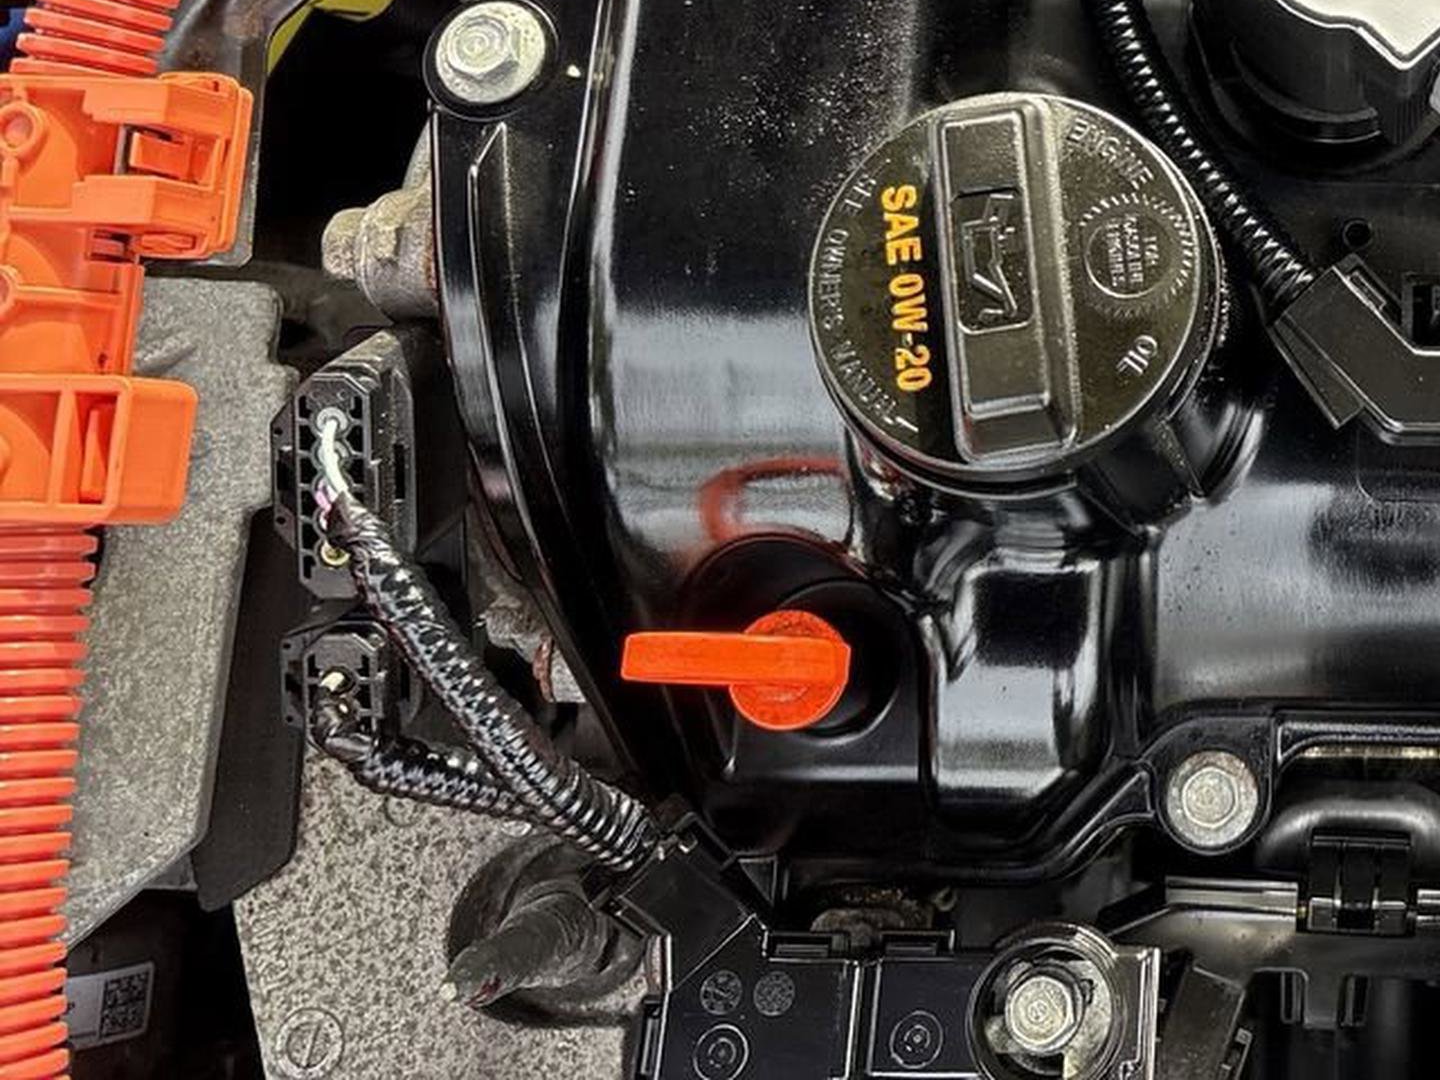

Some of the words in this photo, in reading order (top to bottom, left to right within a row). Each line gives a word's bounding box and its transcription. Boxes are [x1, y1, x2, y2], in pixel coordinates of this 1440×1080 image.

[1066, 117, 1156, 188] ENGINE
[880, 183, 925, 266] SAE
[818, 227, 849, 332] OWNER'S
[887, 273, 932, 393] 0W-20
[1116, 334, 1158, 377] OIL
